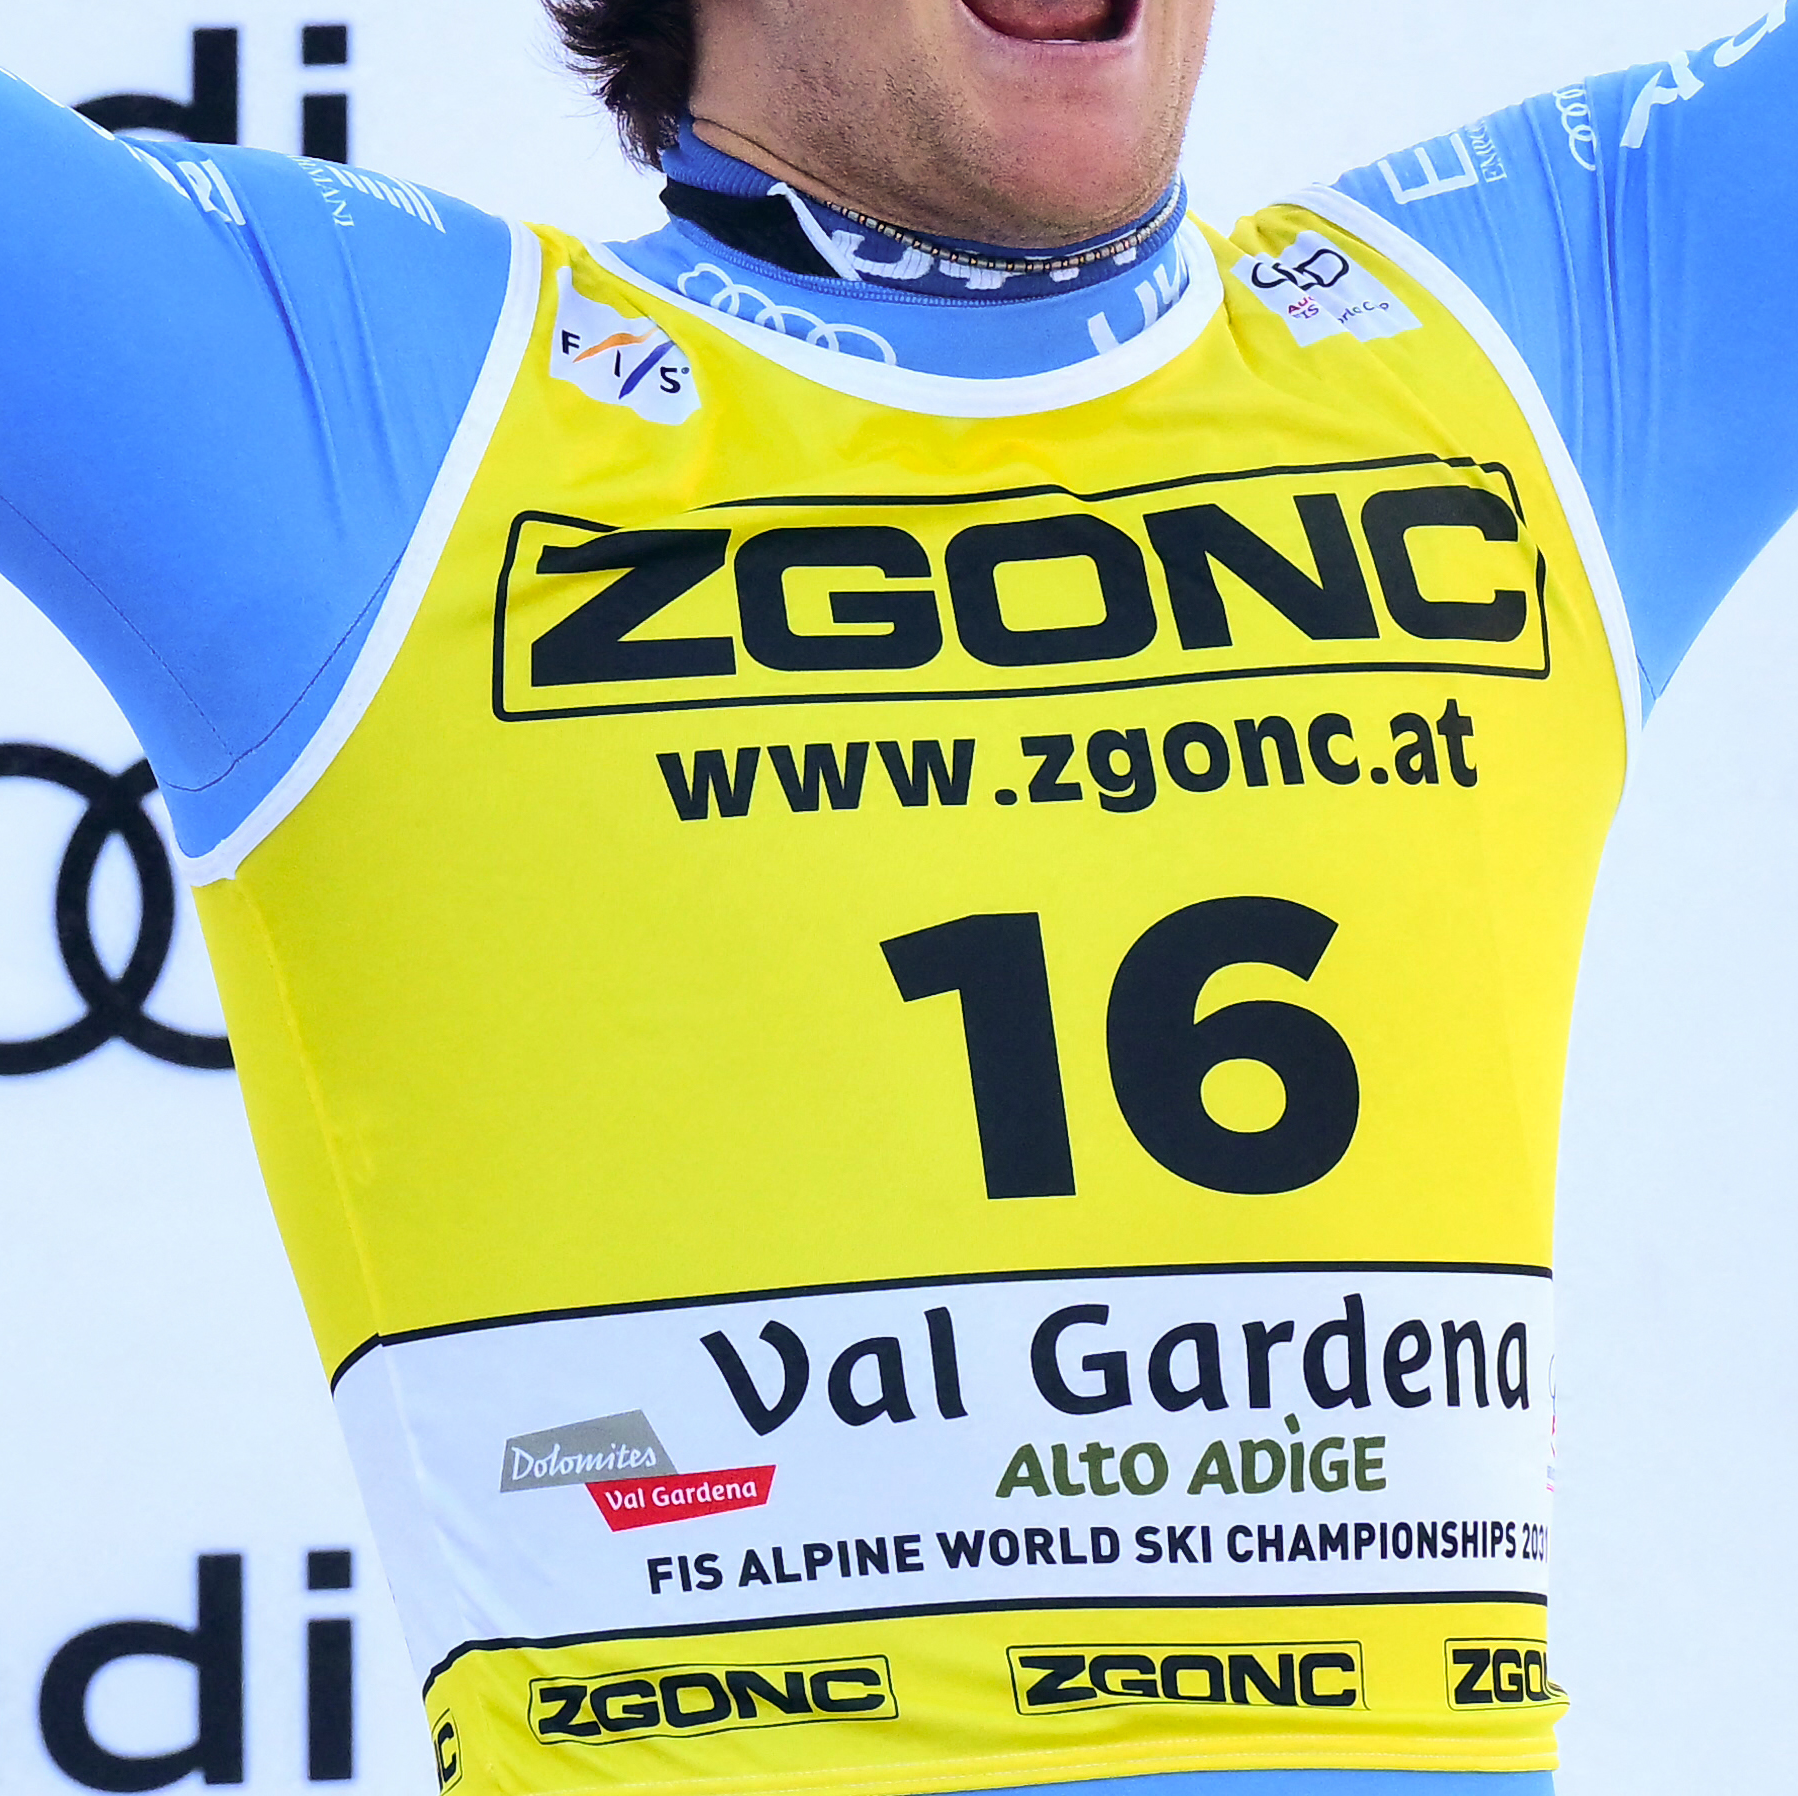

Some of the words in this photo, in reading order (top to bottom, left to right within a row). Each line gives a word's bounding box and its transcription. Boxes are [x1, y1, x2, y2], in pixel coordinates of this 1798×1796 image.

[530, 485, 1528, 687] ZGONC
[655, 698, 1479, 822] www.zgonc.at
[879, 895, 1361, 1201] 16
[699, 1306, 970, 1437] Val
[1030, 1292, 1531, 1416] Gardena
[511, 1442, 658, 1482] Dolomites
[605, 1487, 645, 1511] Val
[652, 1480, 758, 1508] Gardena
[646, 1553, 724, 1595] FIS
[738, 1533, 925, 1588] ALPINE
[935, 1525, 1121, 1570] WORLD
[1134, 1524, 1213, 1564] SKI
[1226, 1520, 1517, 1564] CHAMPIONSHIPS
[537, 1666, 887, 1737] ZGONC
[1018, 1651, 1358, 1708] ZGONC
